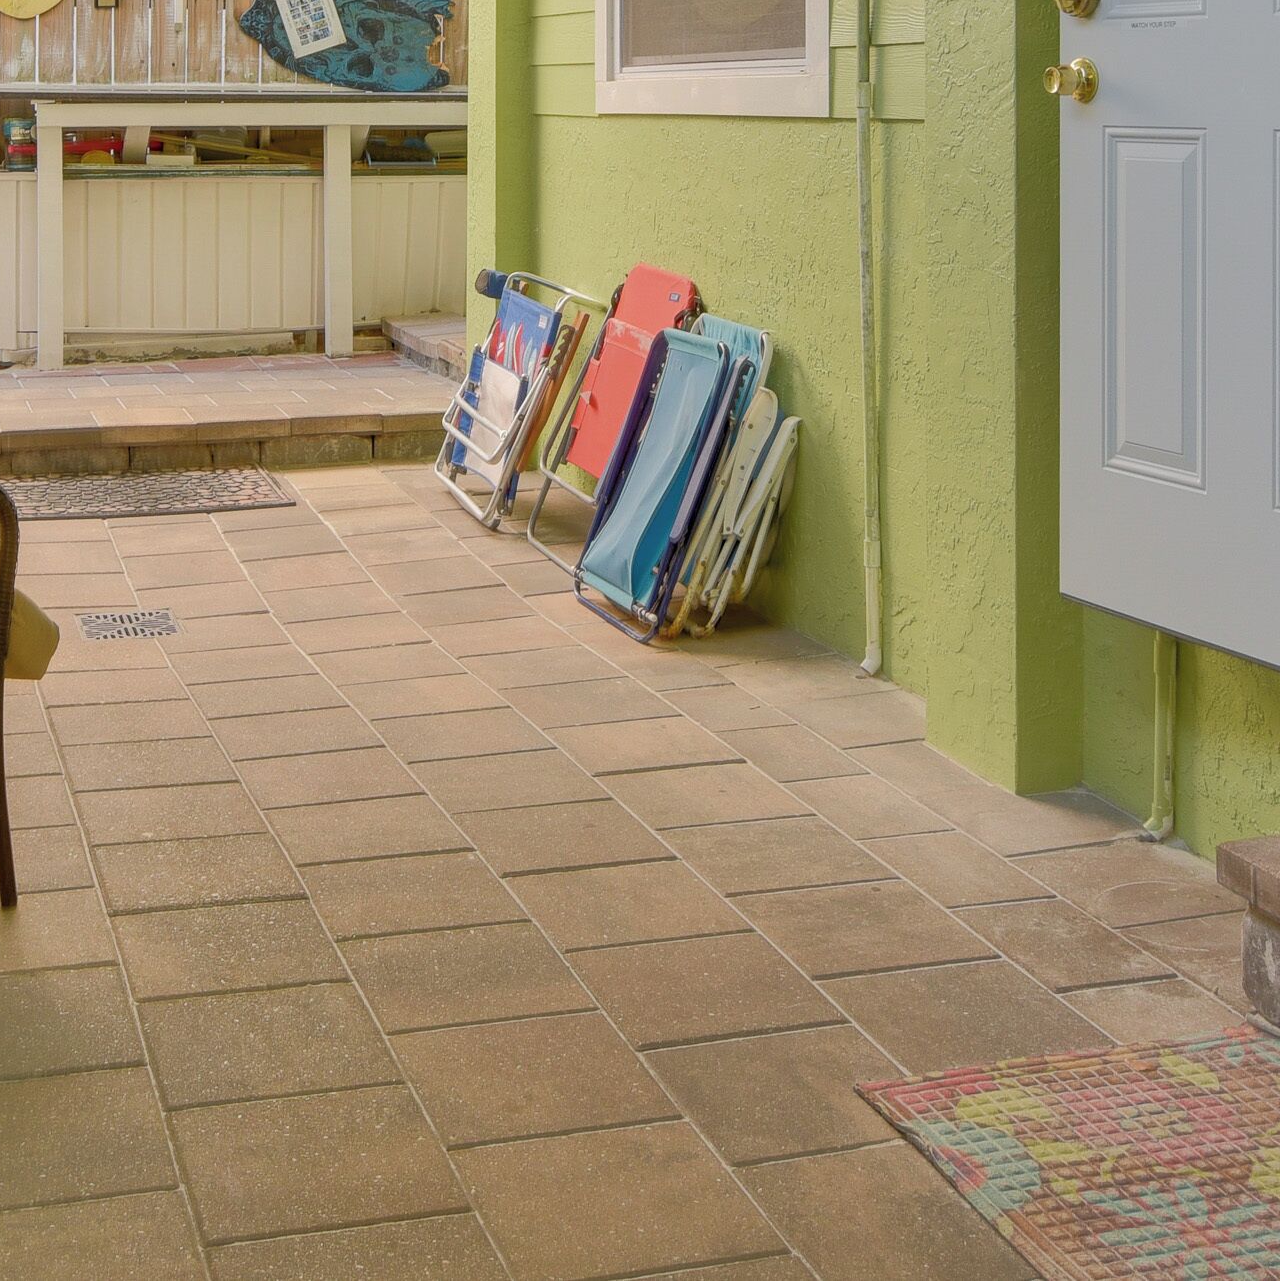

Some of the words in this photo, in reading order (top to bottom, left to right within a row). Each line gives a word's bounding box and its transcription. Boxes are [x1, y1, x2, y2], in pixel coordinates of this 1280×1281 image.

[1131, 21, 1149, 29] WATCH
[1149, 21, 1163, 29] YOUR
[1164, 20, 1177, 28] STEP
